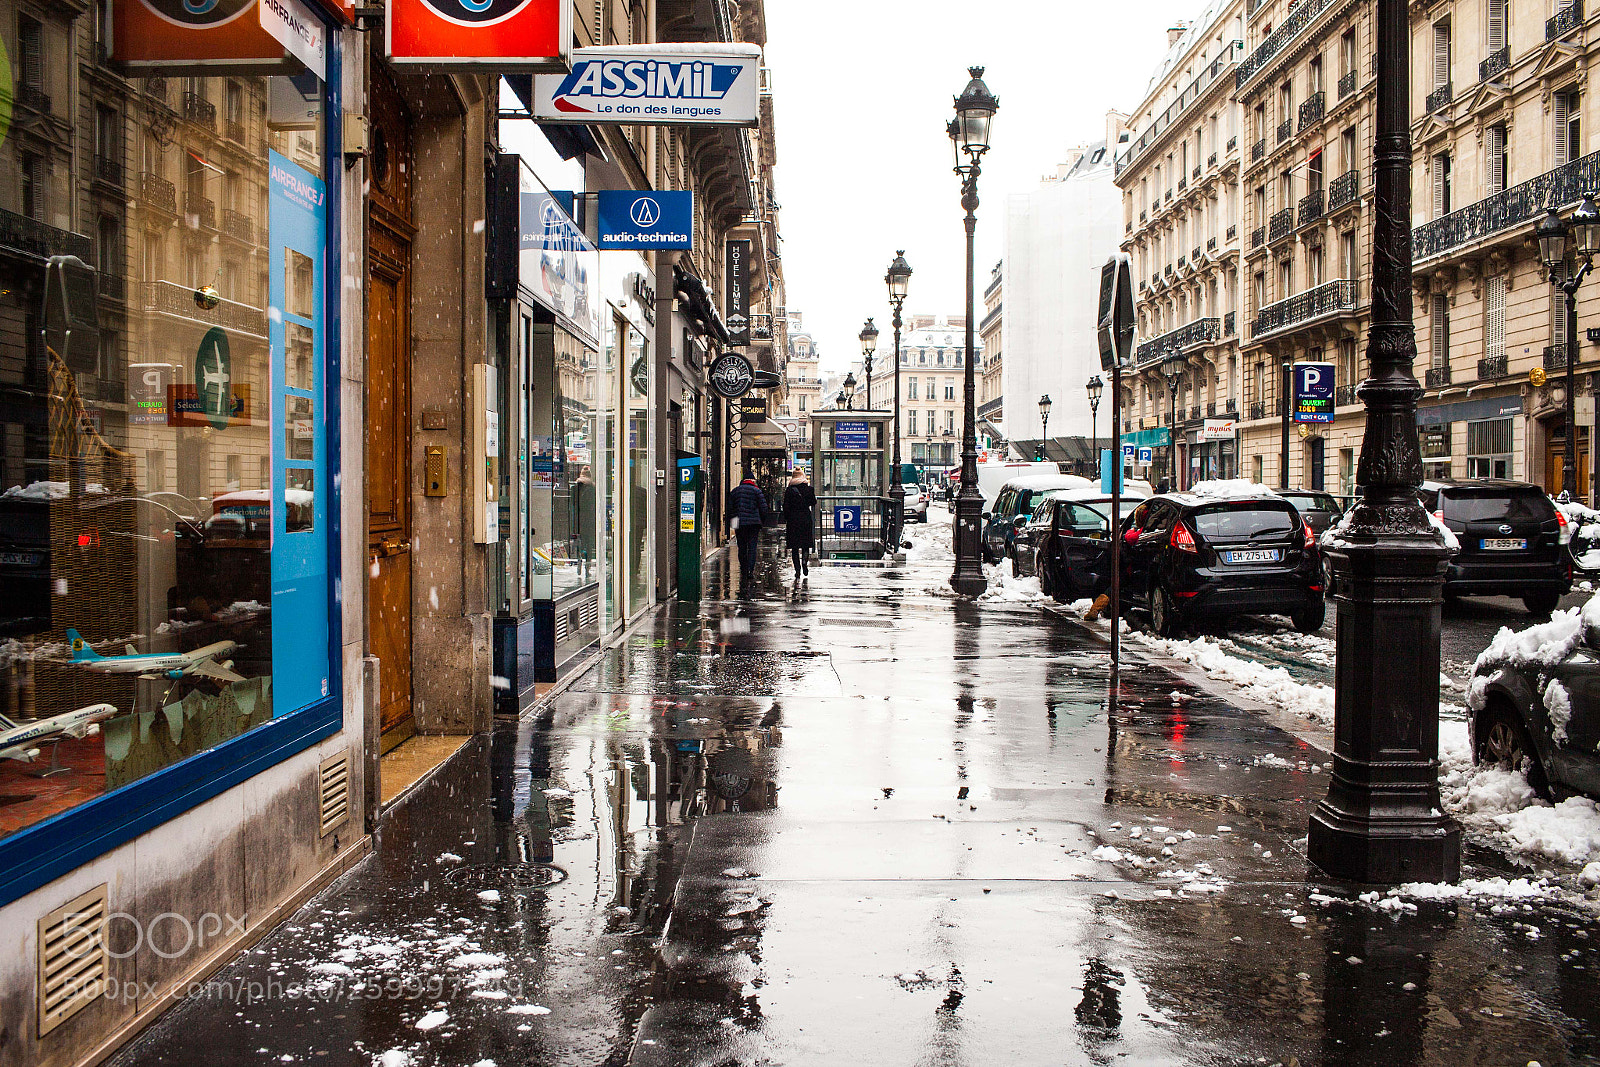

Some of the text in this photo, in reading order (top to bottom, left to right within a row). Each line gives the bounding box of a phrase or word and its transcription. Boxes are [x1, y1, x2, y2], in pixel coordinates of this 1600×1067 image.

[597, 103, 722, 117] Le don des langues
[271, 165, 318, 205] AIRFRANCE
[602, 232, 688, 242] audio-technica
[732, 246, 741, 310] HOTEL LUMEN
[1304, 370, 1321, 392] P
[681, 468, 691, 482] P
[839, 510, 853, 529] P
